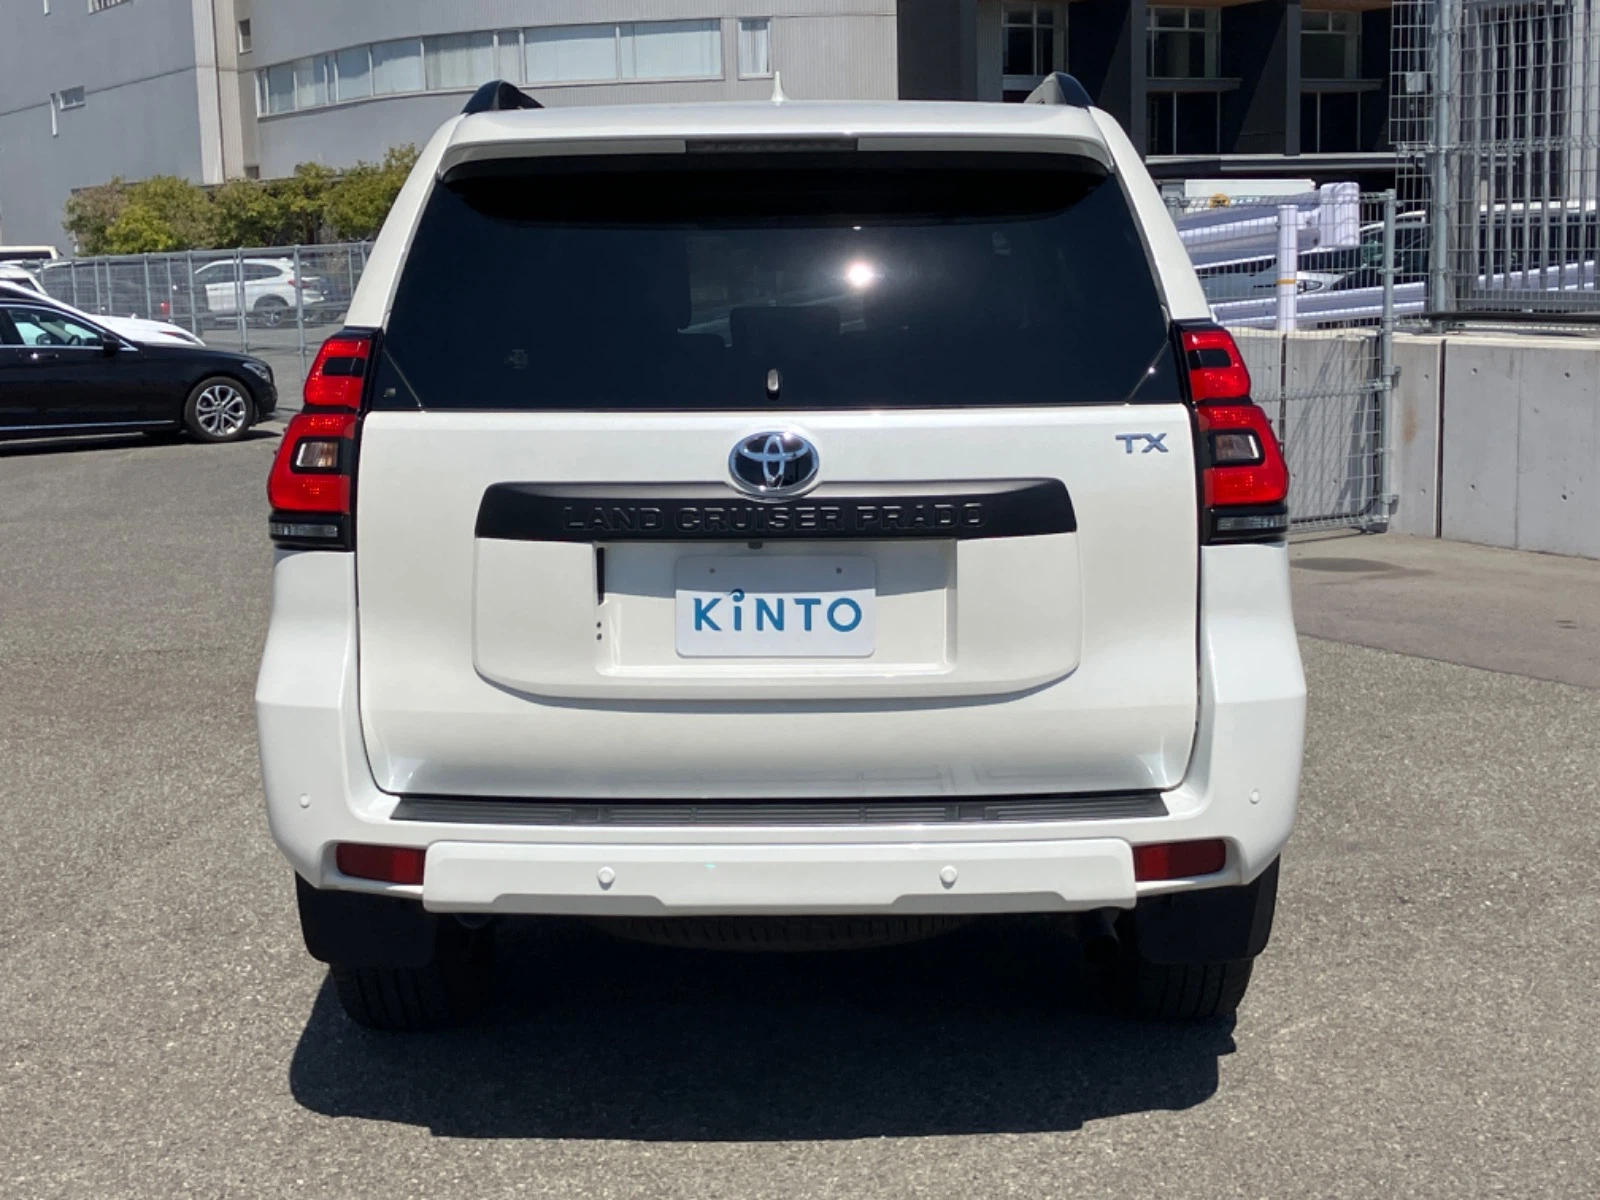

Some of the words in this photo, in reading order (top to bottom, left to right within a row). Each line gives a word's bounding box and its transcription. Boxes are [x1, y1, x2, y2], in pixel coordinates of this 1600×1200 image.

[1115, 432, 1169, 453] TX
[563, 506, 662, 531] LAND
[674, 506, 844, 532] CRUISER
[855, 502, 986, 530] PRADO
